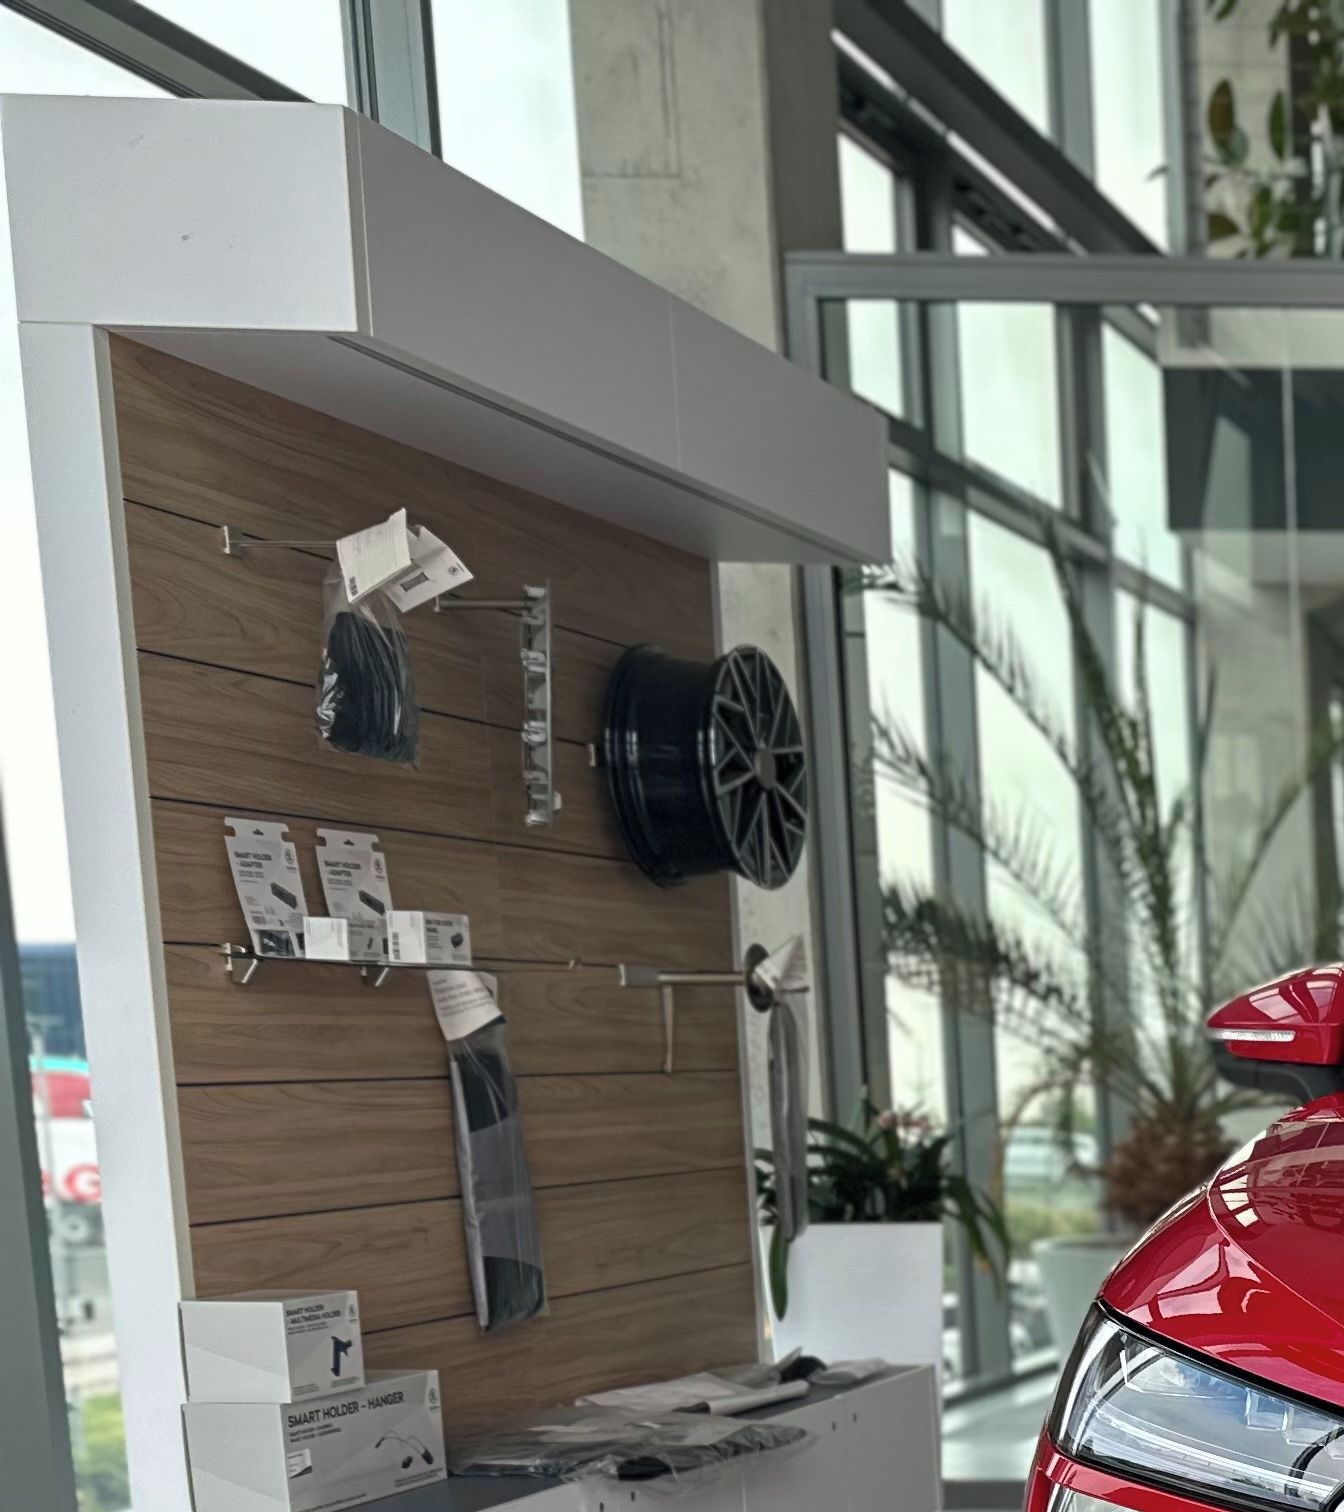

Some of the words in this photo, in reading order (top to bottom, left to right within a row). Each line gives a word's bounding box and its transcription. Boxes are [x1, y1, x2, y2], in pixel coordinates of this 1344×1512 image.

[288, 1409, 321, 1428] SMART
[323, 1401, 360, 1419] HOLDER
[368, 1391, 405, 1410] HANGER
